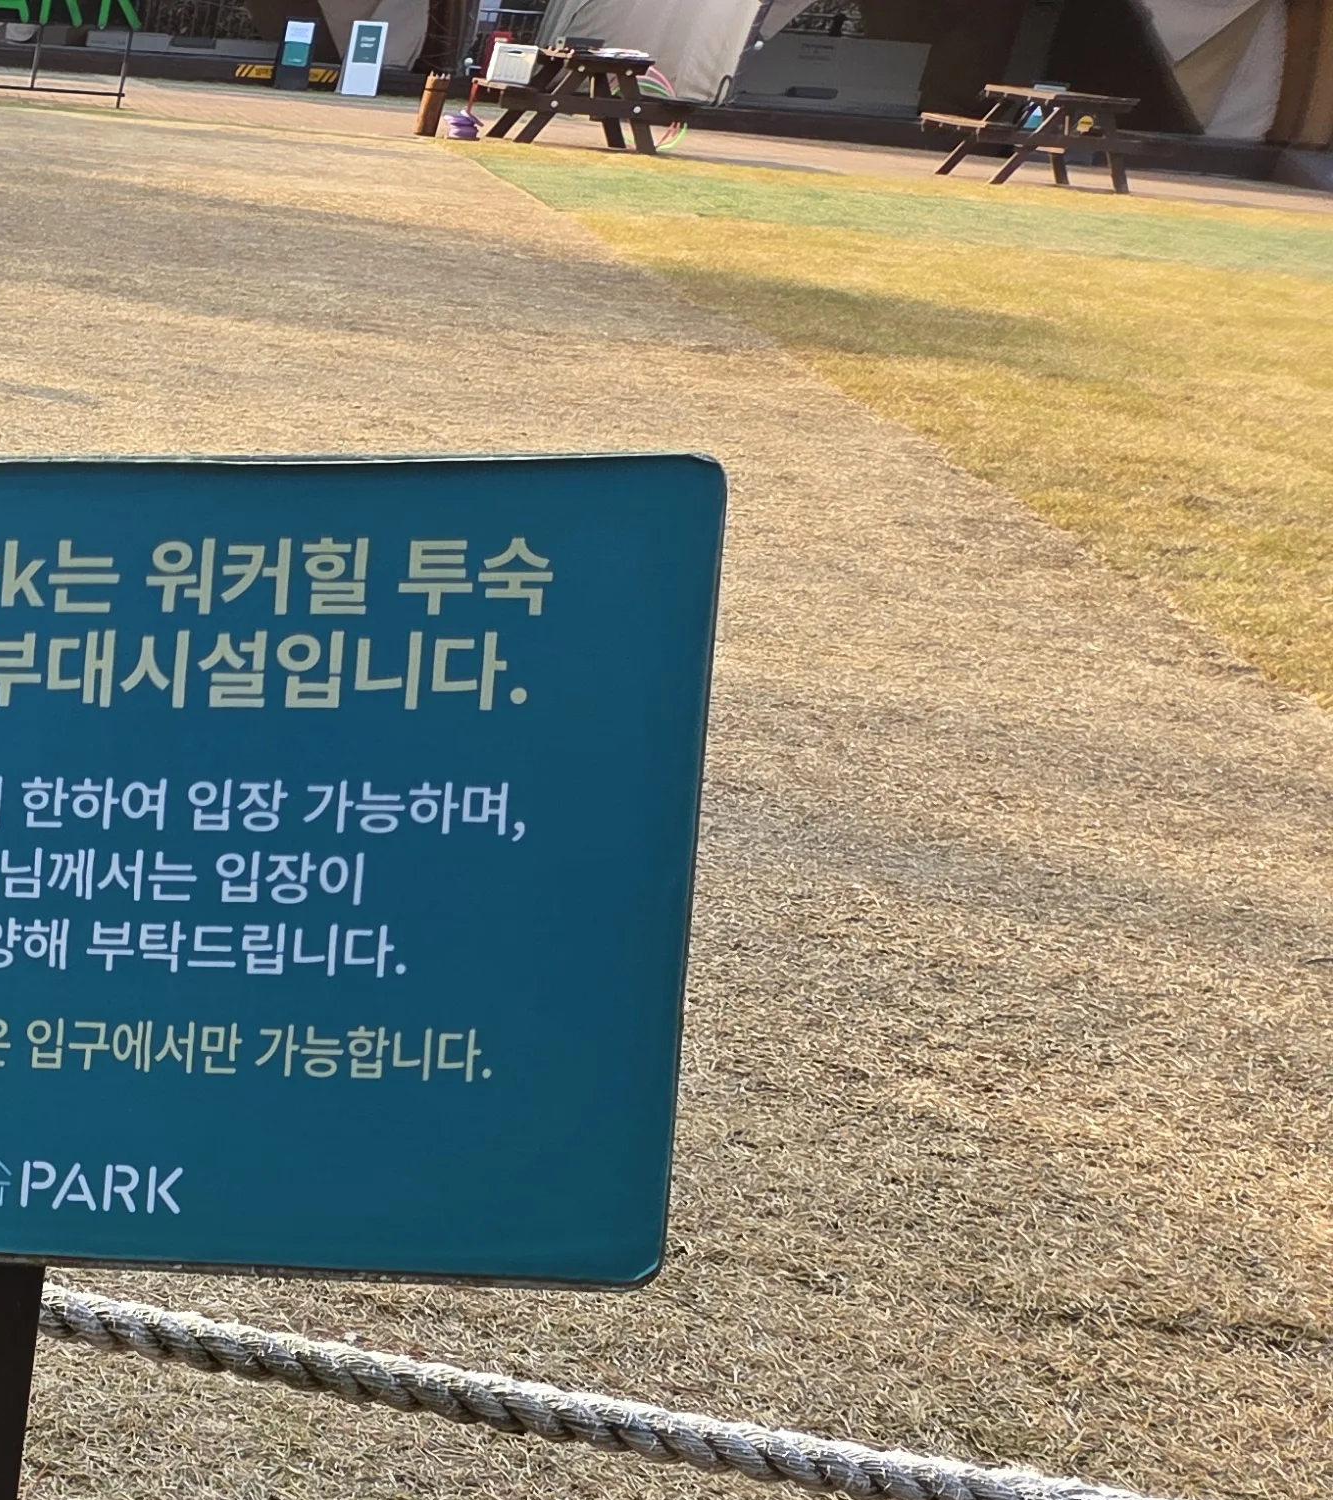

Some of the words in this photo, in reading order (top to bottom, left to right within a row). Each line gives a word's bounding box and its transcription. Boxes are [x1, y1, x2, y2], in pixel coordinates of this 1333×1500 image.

[146, 537, 369, 615] 워커힐
[398, 537, 553, 616] 투숙
[21, 776, 167, 831] 한하여
[188, 779, 289, 832] 입장
[303, 780, 525, 842] 가능하며,
[215, 851, 365, 906] 입장이
[86, 920, 406, 978] 부탁드립니다.
[26, 1017, 243, 1074] 입구에서만
[255, 1024, 492, 1082] 가능합니다.
[19, 1159, 183, 1214] PARK
